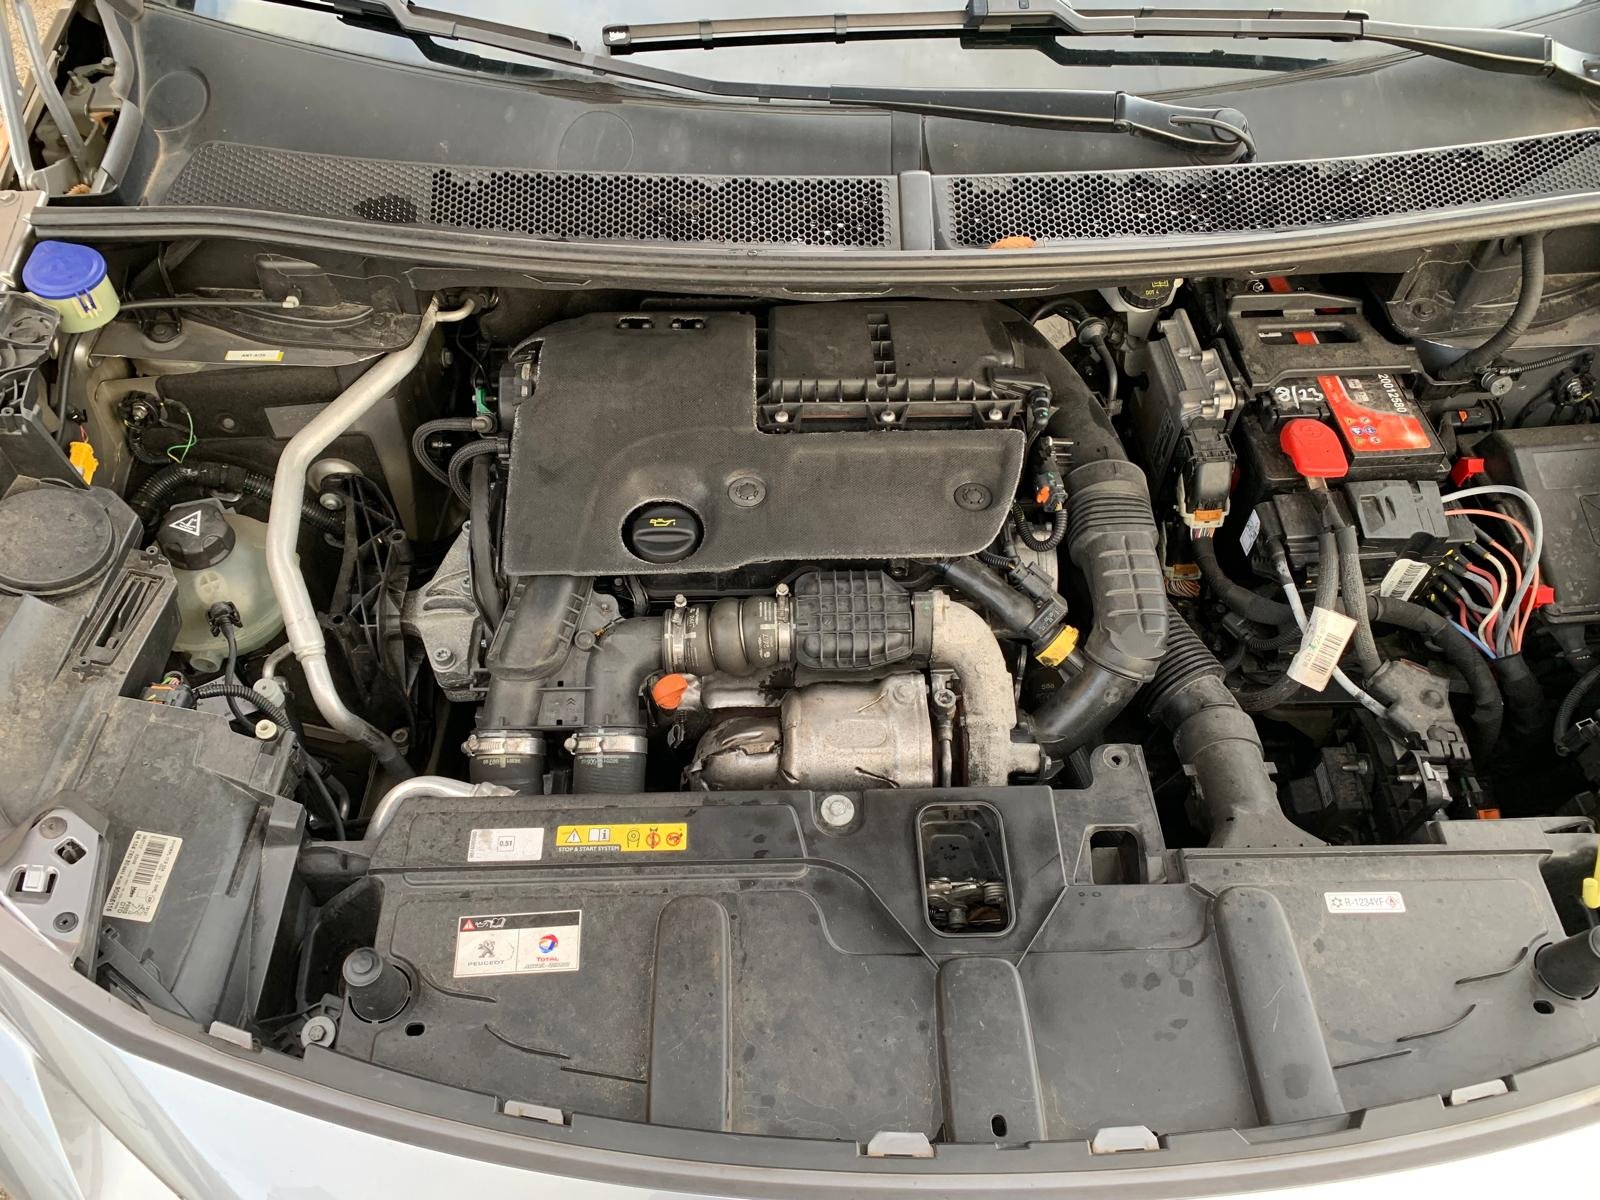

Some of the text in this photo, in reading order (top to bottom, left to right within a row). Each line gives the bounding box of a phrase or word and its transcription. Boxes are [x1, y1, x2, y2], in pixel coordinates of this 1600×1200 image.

[1274, 385, 1325, 410] 8/23
[1377, 373, 1408, 414] 20012580
[1344, 897, 1385, 907] R-1234YF
[467, 959, 505, 967] PEUGEOT
